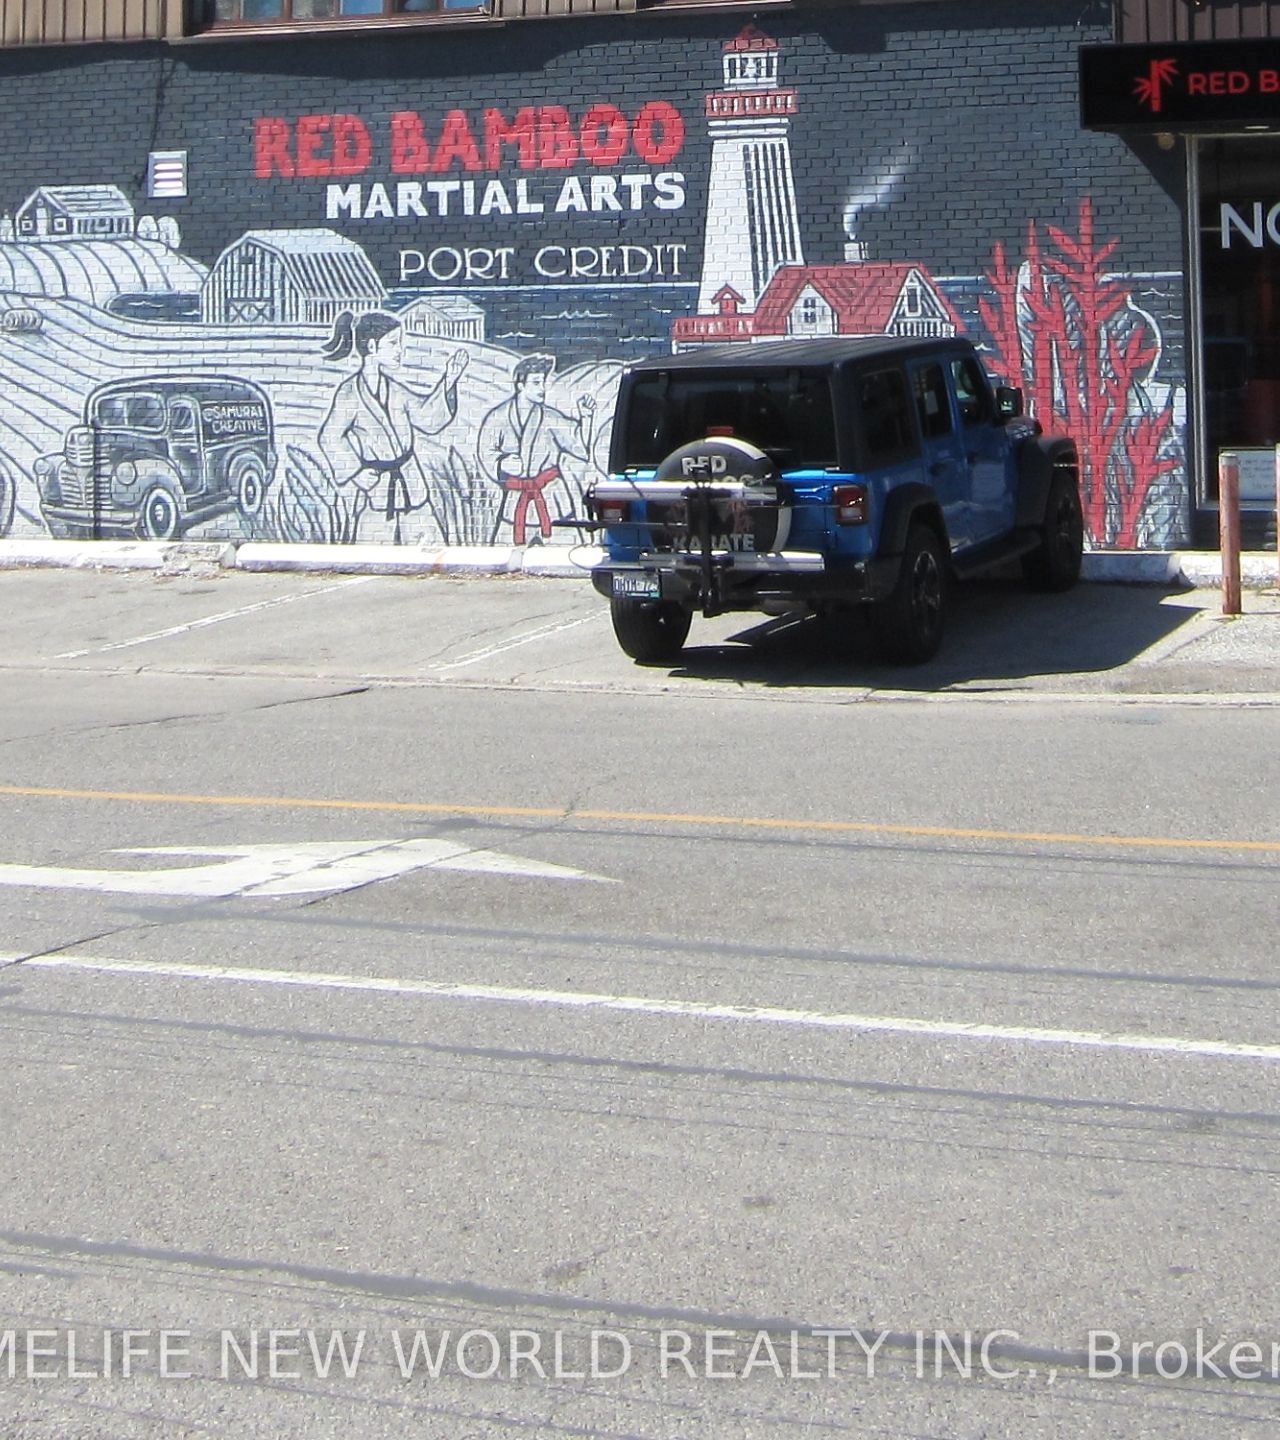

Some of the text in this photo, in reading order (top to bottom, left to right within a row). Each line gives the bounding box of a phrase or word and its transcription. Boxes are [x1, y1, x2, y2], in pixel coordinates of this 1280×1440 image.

[1188, 70, 1250, 96] RED
[253, 100, 686, 178] RED BAMBOO
[326, 171, 687, 220] MARTIAL ARTS
[399, 243, 688, 282] PORT CREDIT
[681, 455, 727, 476] RED
